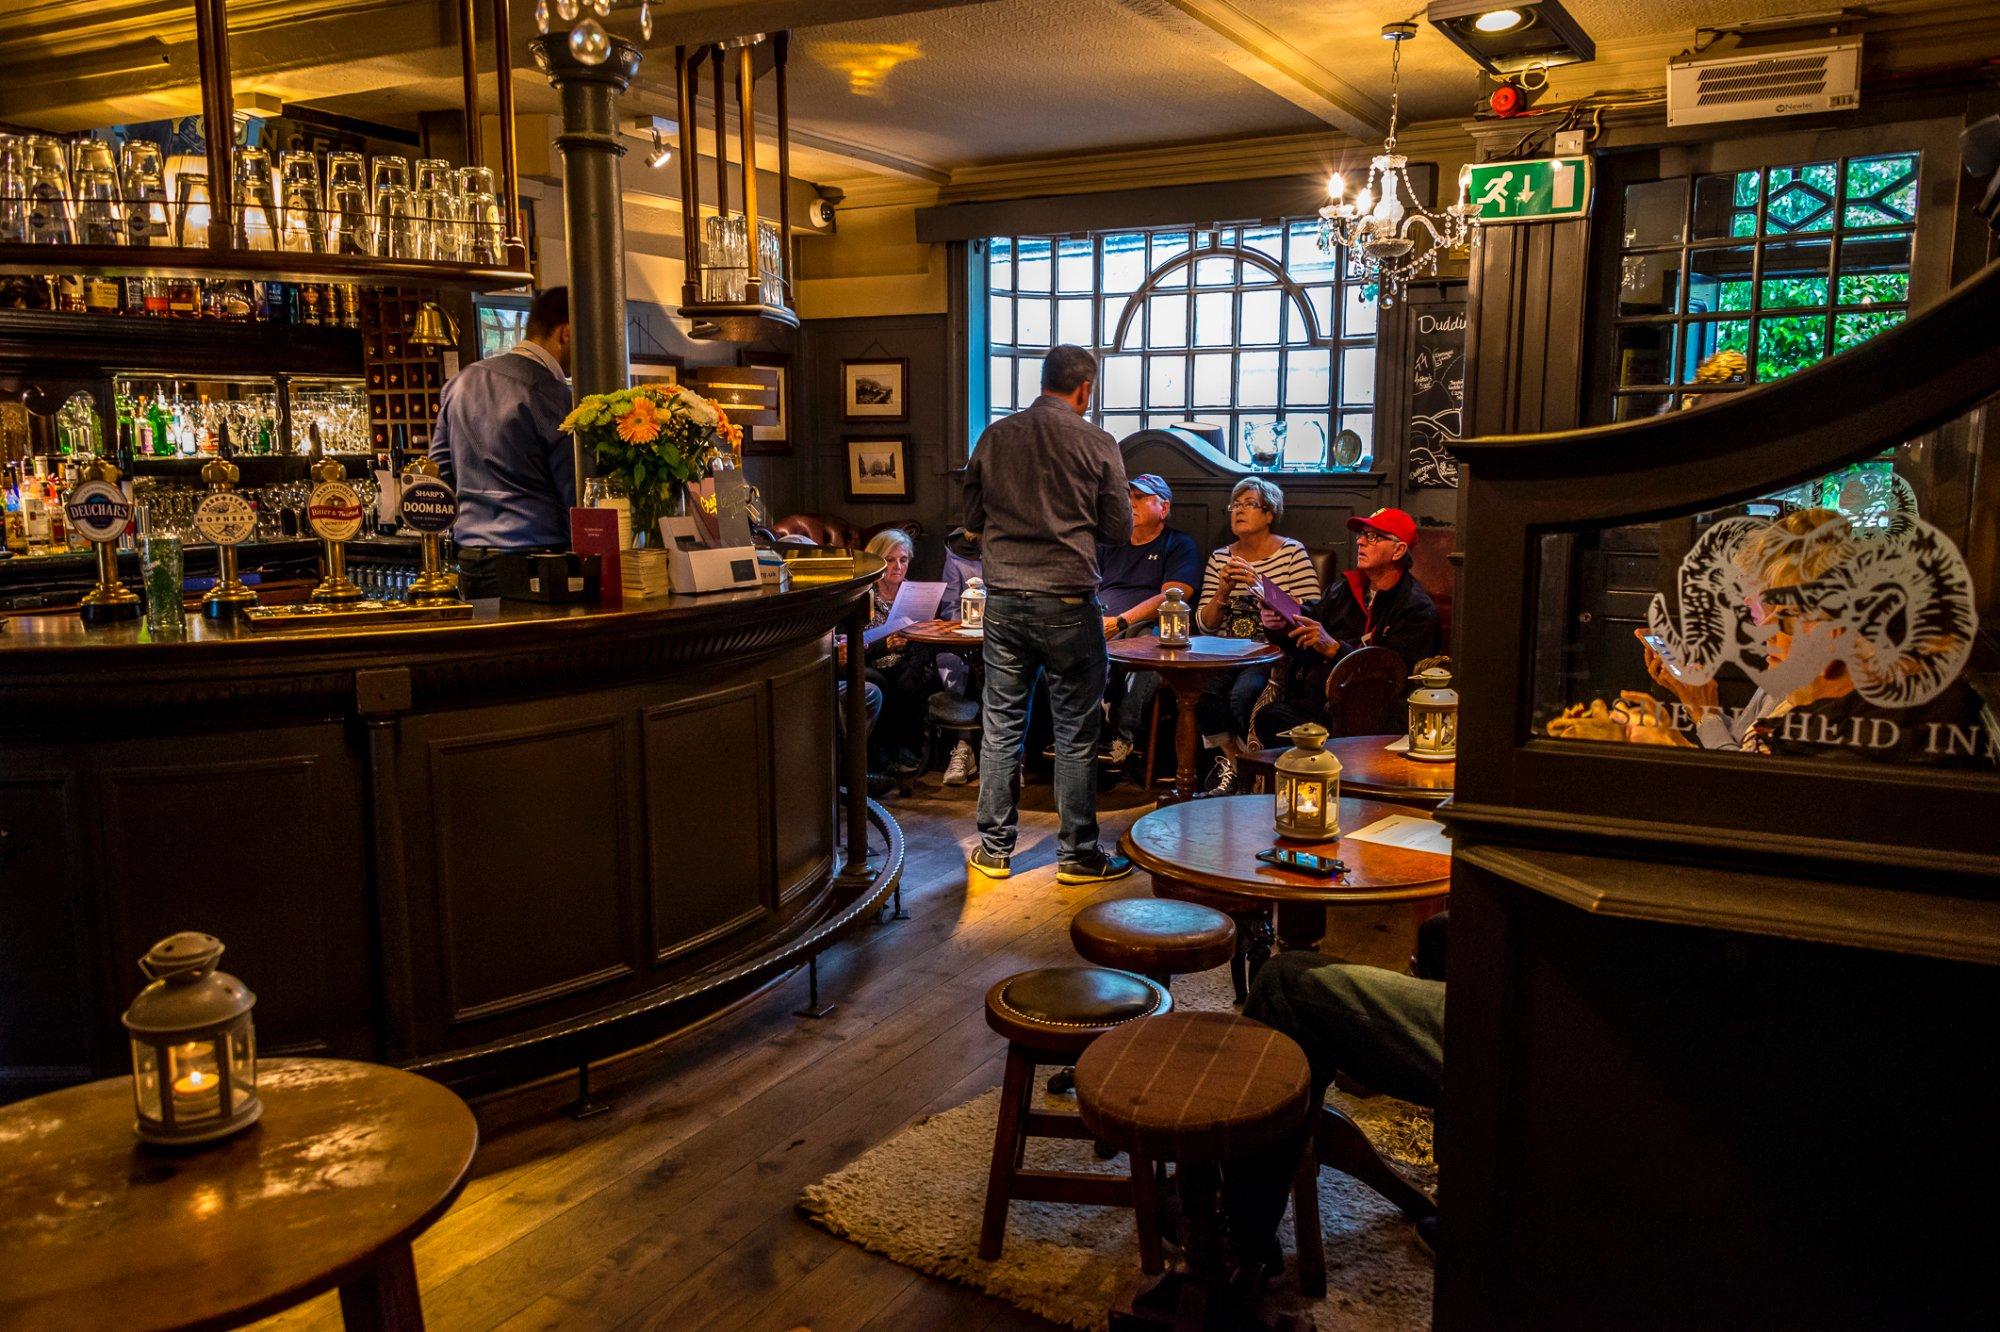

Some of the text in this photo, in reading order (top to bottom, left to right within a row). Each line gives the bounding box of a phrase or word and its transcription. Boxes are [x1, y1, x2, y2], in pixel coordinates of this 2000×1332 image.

[1418, 312, 1467, 334] Duddi
[415, 490, 445, 499] SHARP'S
[69, 503, 128, 519] DEUCHARS
[403, 501, 455, 515] DOOM BAR
[197, 515, 253, 523] HOPHEAD
[1780, 712, 1900, 748] HEID
